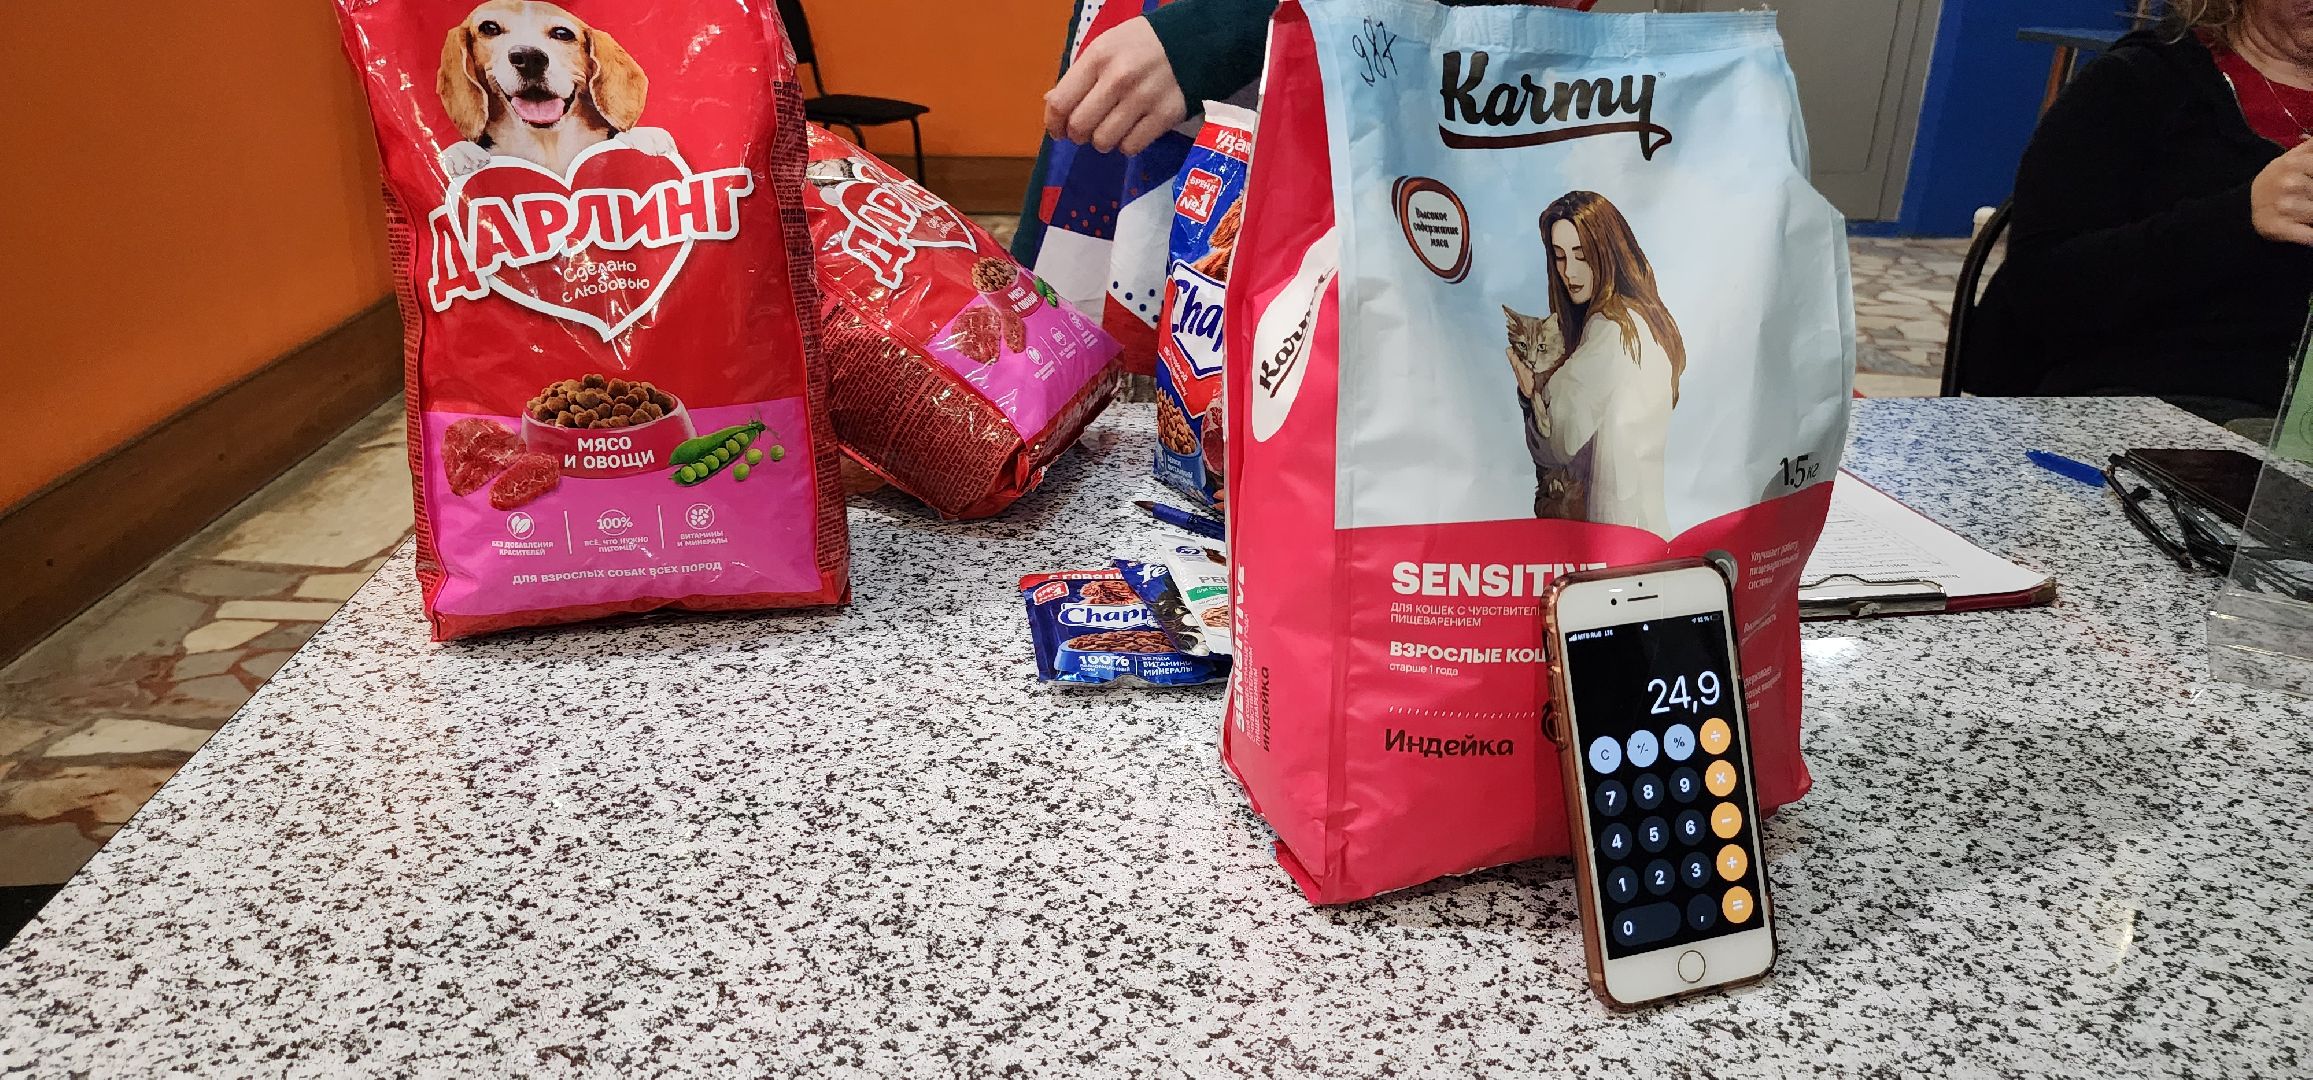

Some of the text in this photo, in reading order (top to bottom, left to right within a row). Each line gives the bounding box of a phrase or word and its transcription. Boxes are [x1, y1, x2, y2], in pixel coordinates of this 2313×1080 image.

[1440, 51, 1668, 161] Karmy
[1415, 207, 1448, 221] Высокое
[1413, 221, 1459, 236] содержание
[430, 169, 753, 310] ДАРЛИНГ
[563, 260, 637, 282] Сделано
[574, 277, 650, 299] любовью
[577, 436, 632, 453] МЯСО
[564, 449, 656, 469] И ОВОЩИ
[1780, 454, 1809, 489] 1.5
[597, 516, 634, 530] 100%
[680, 530, 724, 540] ВИТАМИНЫ
[684, 537, 729, 547] МИНЕРАЛЫ
[512, 561, 724, 586] ДЛЯ ВЗРОСЛЫХ СОБАК ВСЕХ ПОРОД
[1392, 561, 1607, 597] SENSIT
[1390, 602, 1540, 617] ДЛЯ КОШЕК С ЧУВСТВИТЕЛ
[1390, 613, 1482, 627] ПИЩЕВАРЕНИЕМ
[1233, 563, 1245, 733] SENSITIVE
[1389, 640, 1502, 664] ВЗРОСЛЫЕ
[1078, 655, 1130, 667] 100%
[1143, 660, 1193, 669] ВИТАМИНЫ
[1389, 663, 1459, 677] старше 1 года
[1143, 666, 1193, 677] МИНЕРАЛЫ
[1647, 670, 1720, 715] 24,9
[1385, 728, 1514, 759] Индейка
[1600, 749, 1610, 761] C
[1605, 790, 1617, 807] 7
[1642, 784, 1654, 800] 8
[1679, 777, 1690, 793] 9
[1611, 833, 1622, 849] 4
[1649, 826, 1659, 842] 5
[1685, 819, 1696, 835] 6
[1618, 877, 1627, 892] 1
[1654, 869, 1665, 885] 2
[1690, 862, 1701, 878] 3
[1622, 920, 1633, 936] 0
